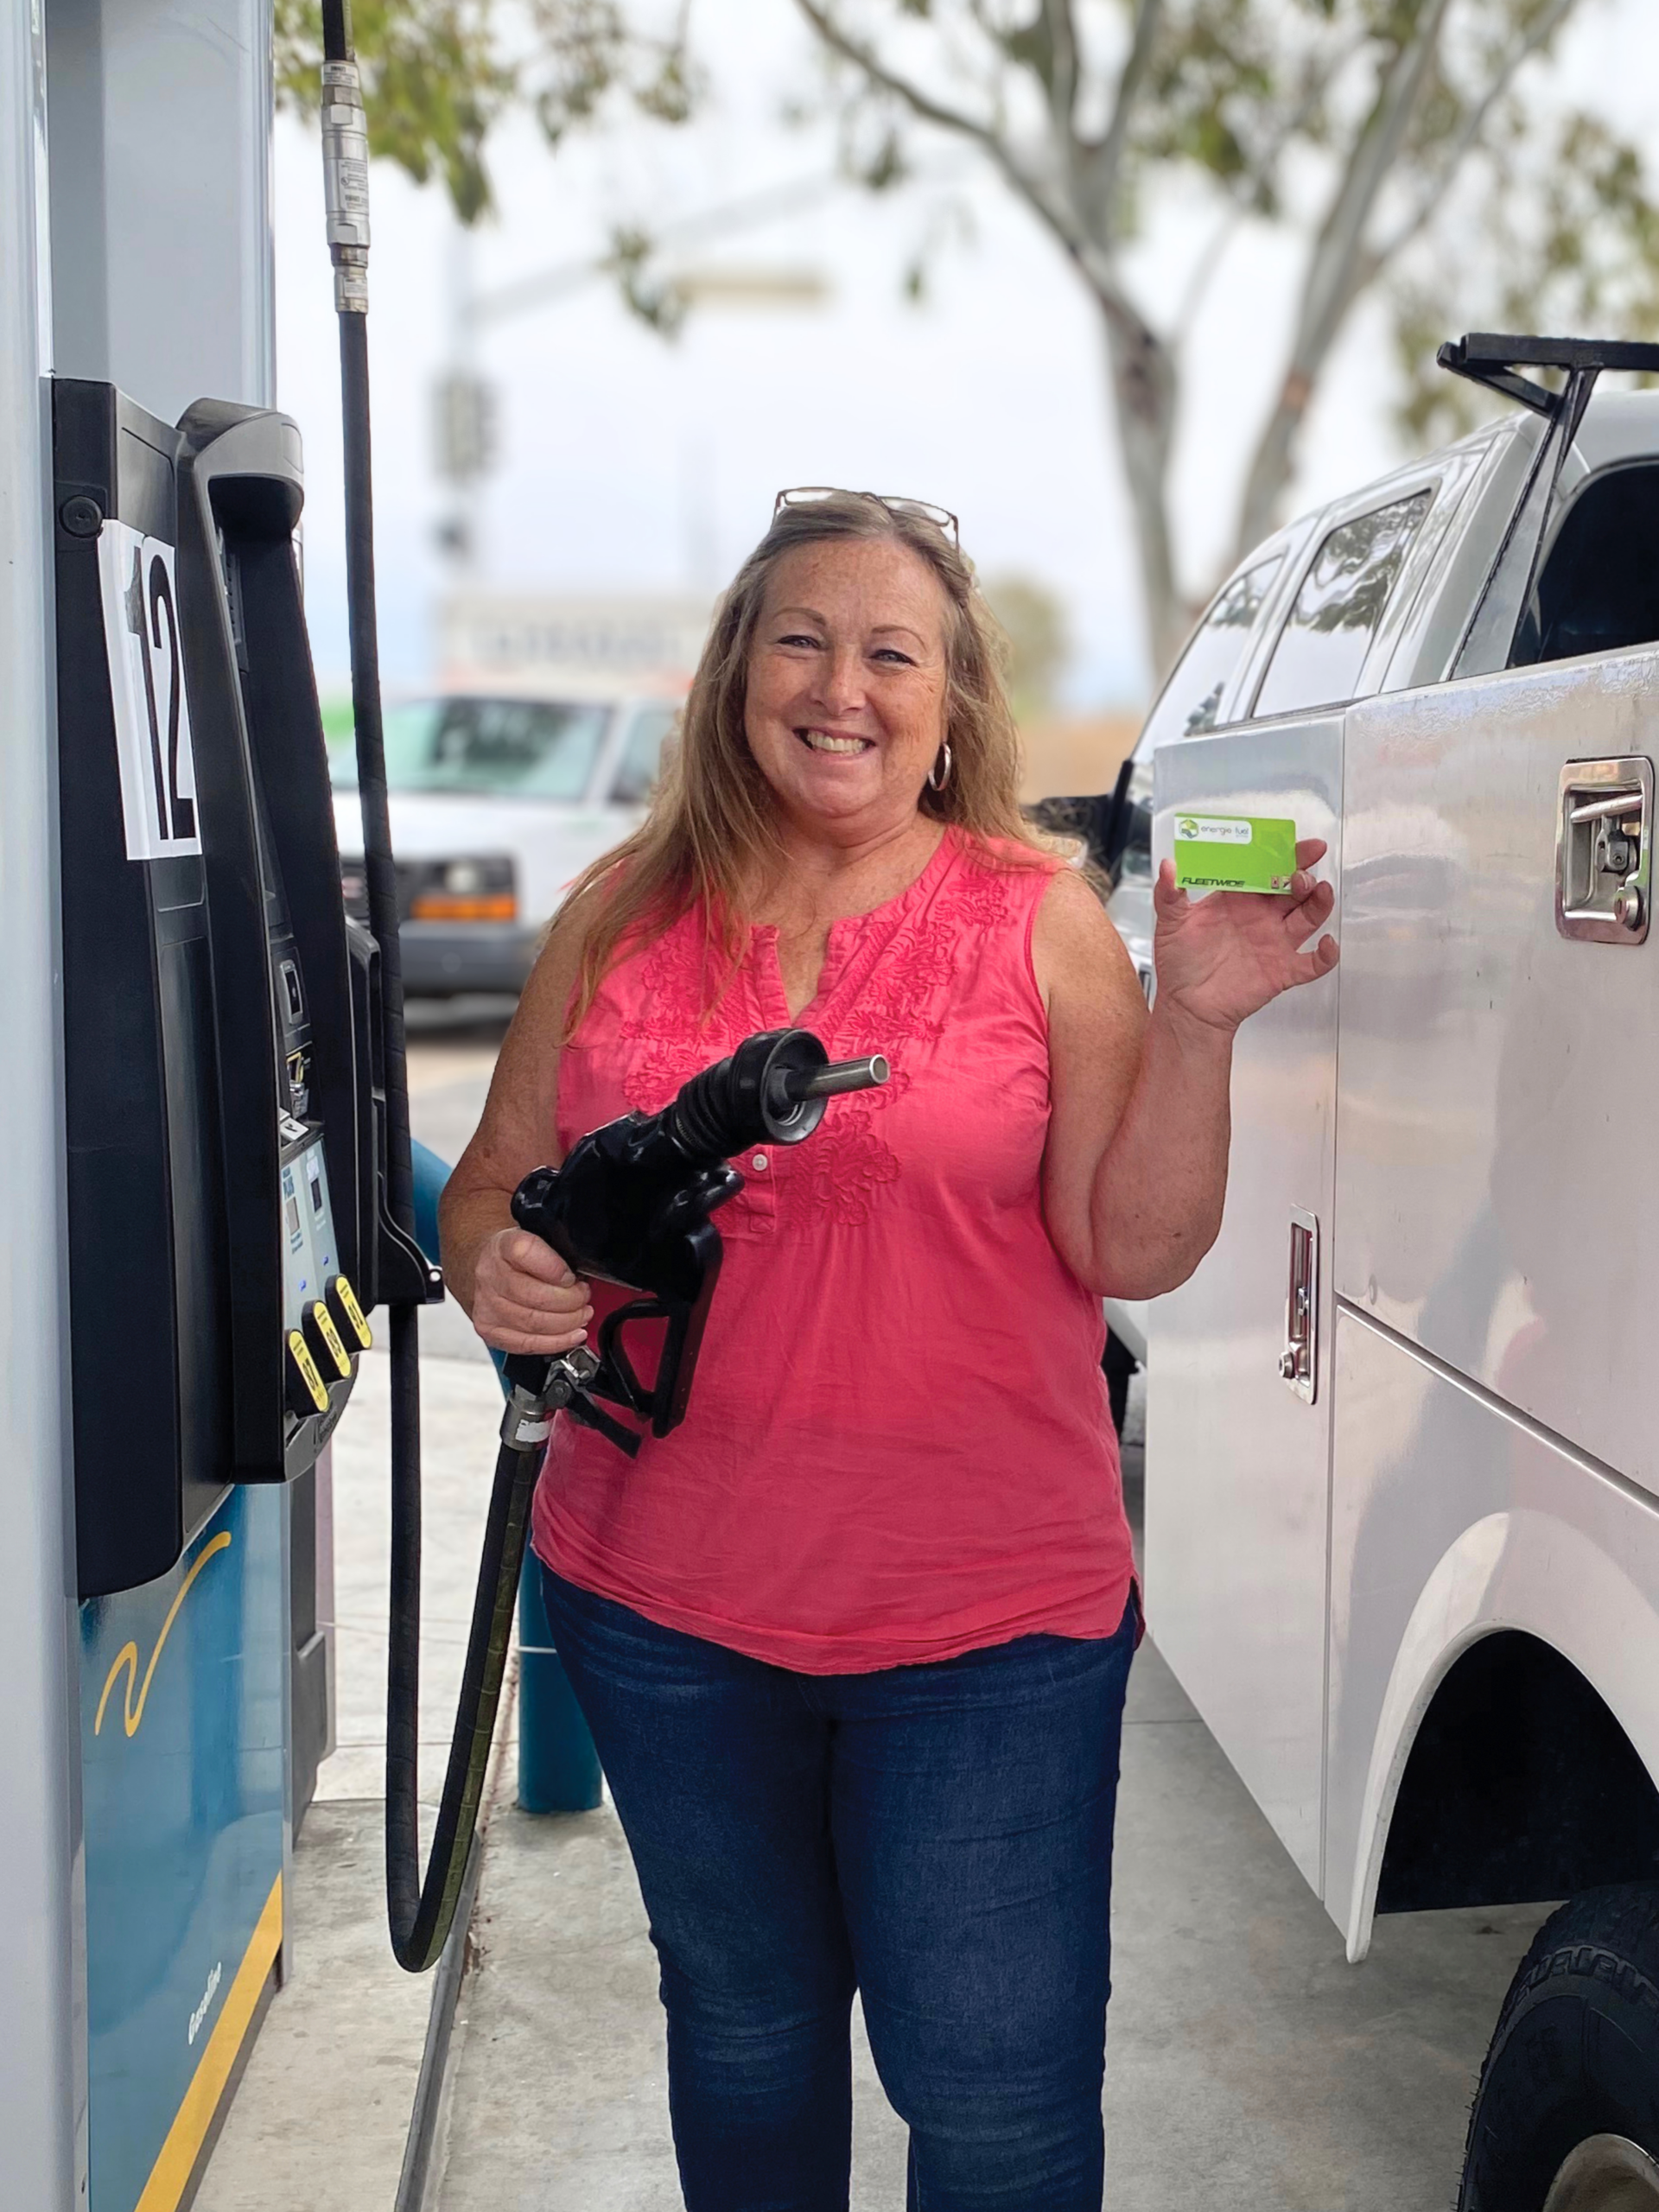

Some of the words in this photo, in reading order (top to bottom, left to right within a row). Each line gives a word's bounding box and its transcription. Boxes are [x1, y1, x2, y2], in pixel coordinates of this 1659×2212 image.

[124, 546, 196, 841] 12
[1200, 825, 1232, 836] energie
[1181, 876, 1245, 888] FLEETWIDE
[302, 1357, 319, 1392] 87
